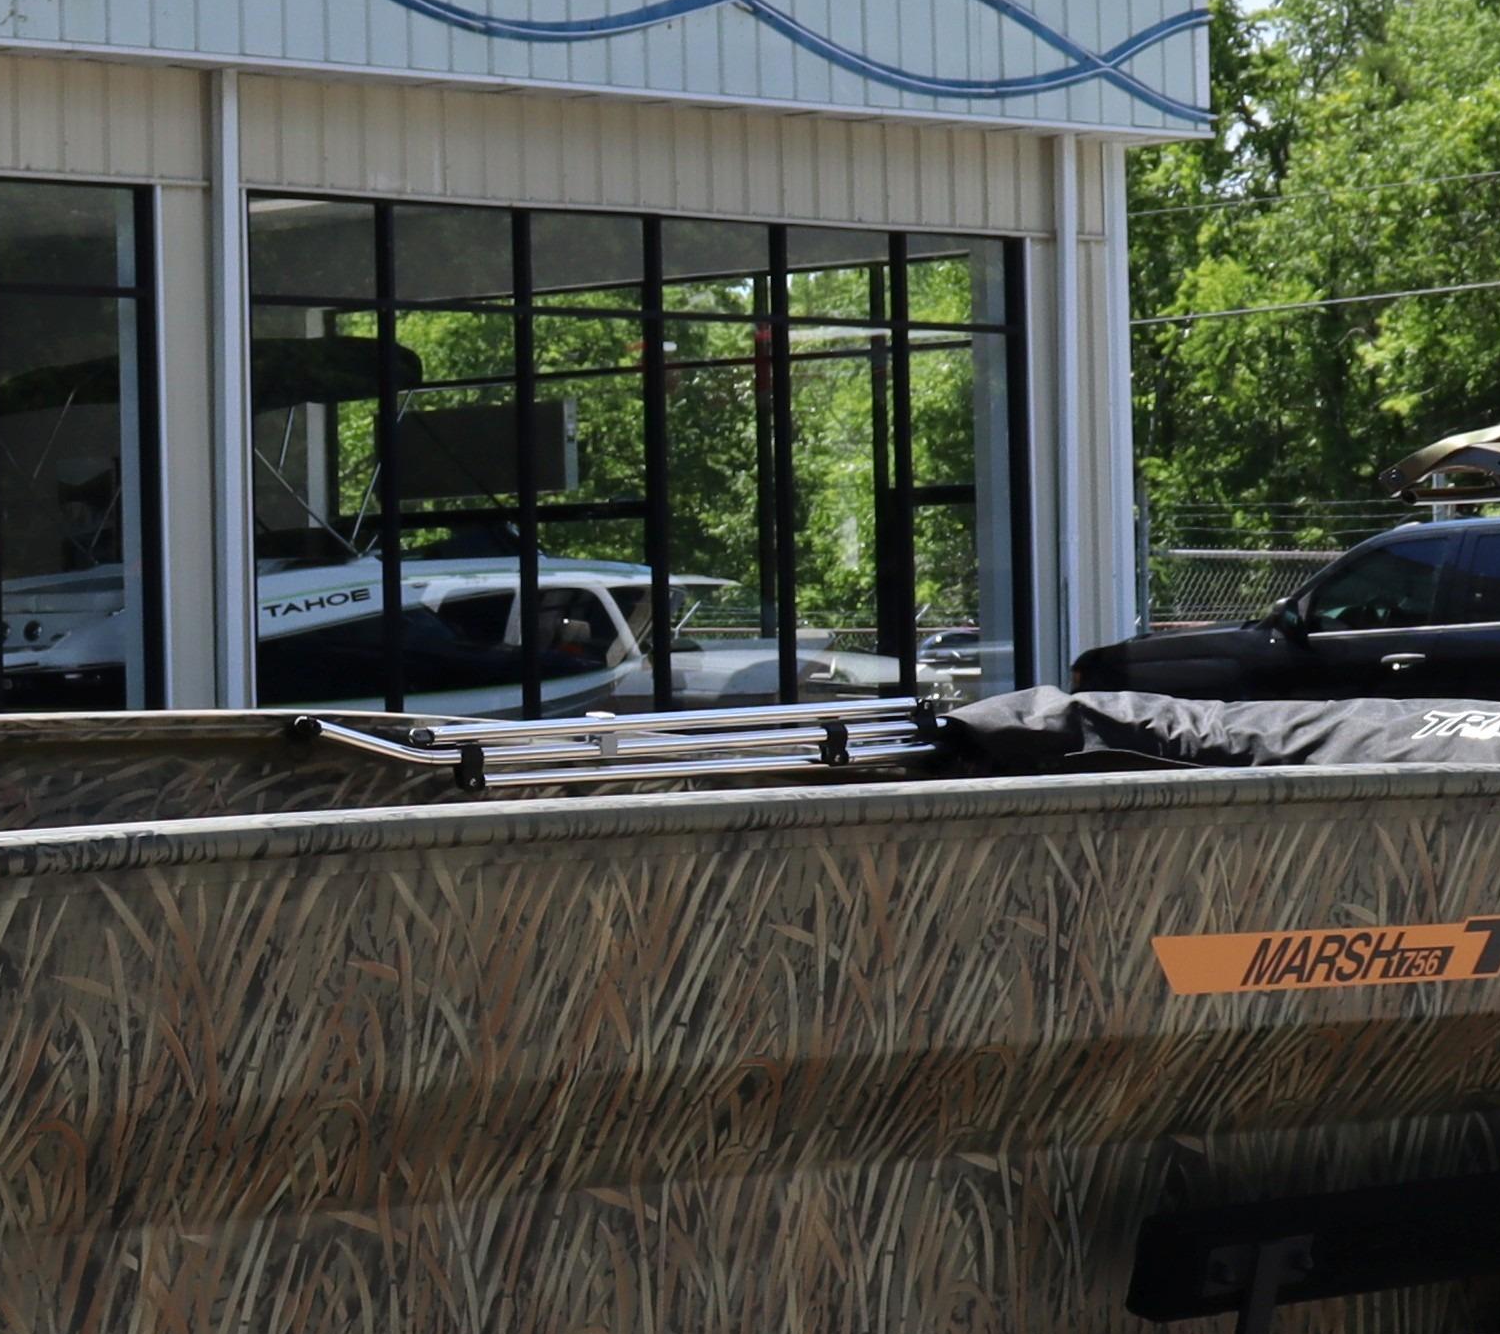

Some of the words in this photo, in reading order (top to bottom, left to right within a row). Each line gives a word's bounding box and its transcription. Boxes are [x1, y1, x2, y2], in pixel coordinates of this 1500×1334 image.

[262, 588, 371, 617] TAHOE
[1240, 931, 1405, 986] MARSH
[1389, 949, 1443, 977] 1756
